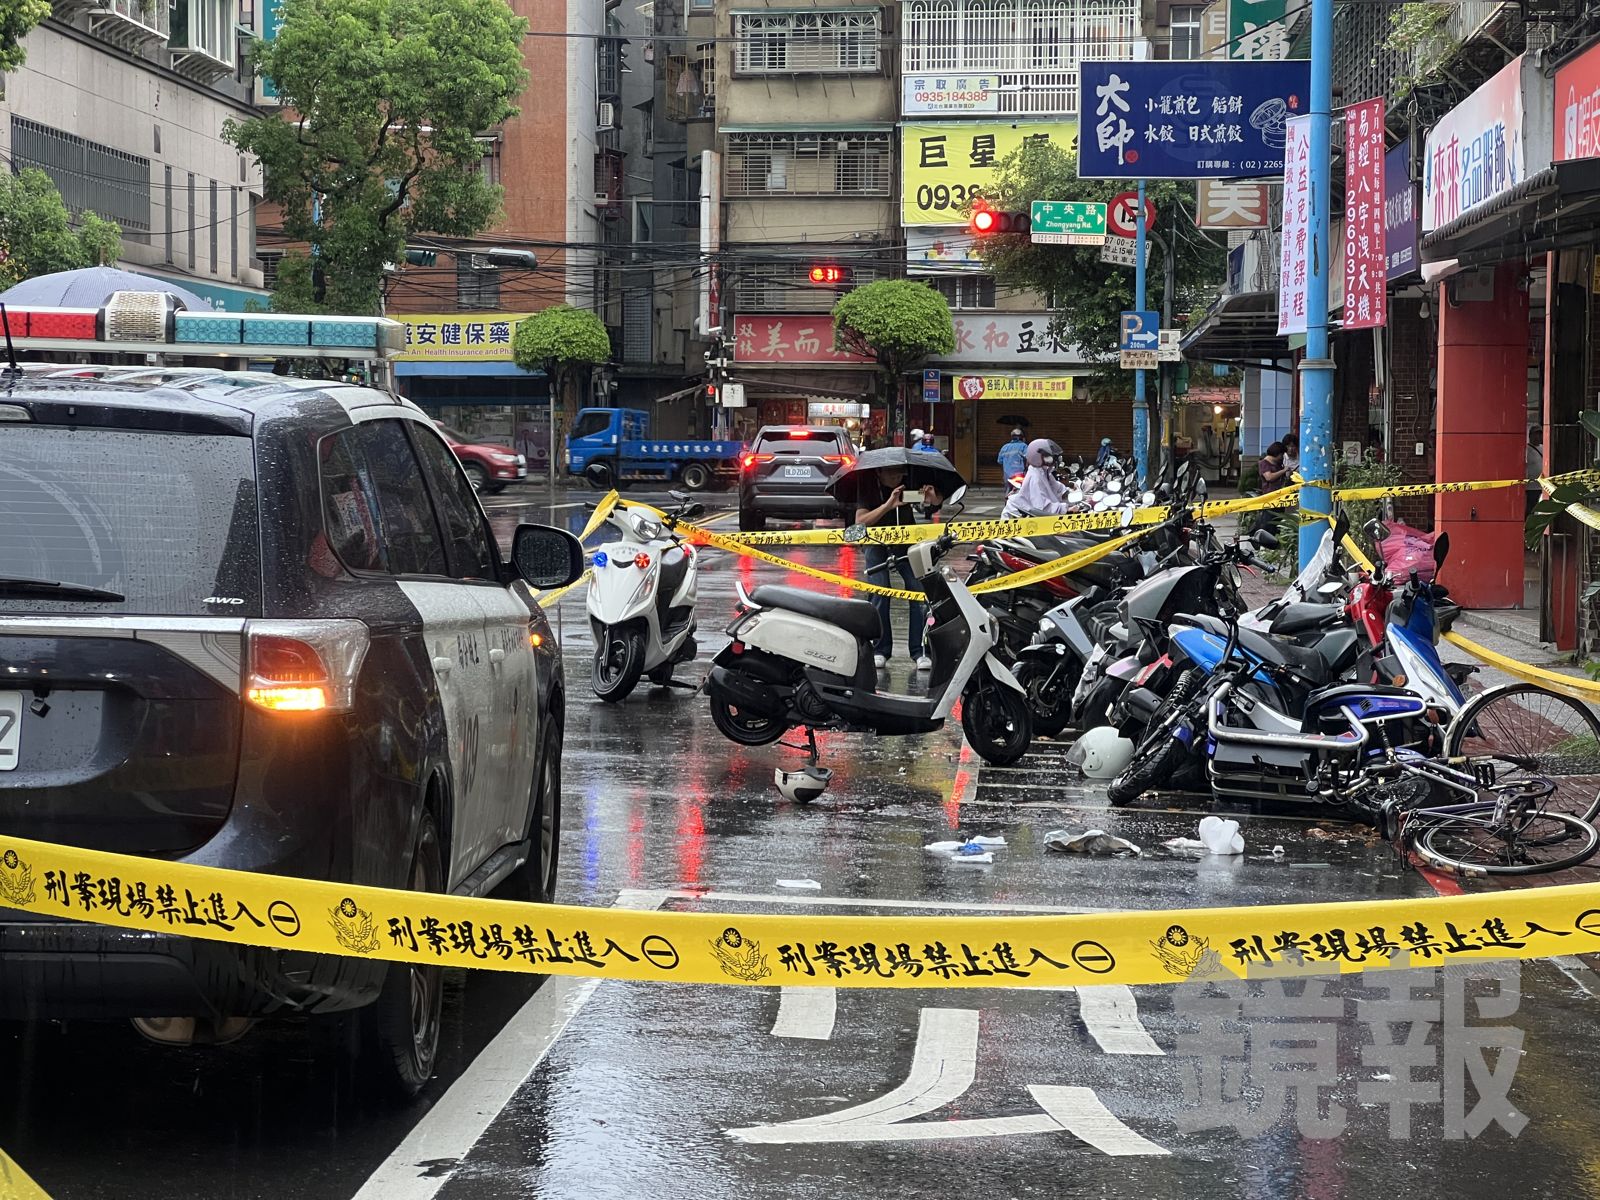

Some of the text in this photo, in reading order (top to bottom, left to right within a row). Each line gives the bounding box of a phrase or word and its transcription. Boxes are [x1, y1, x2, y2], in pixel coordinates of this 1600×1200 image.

[915, 92, 988, 102] 0935-184388
[1144, 95, 1243, 115] 小籠煎包 餡餅
[1096, 73, 1135, 165] 大帥
[1144, 124, 1243, 143] 水餃 日式煎餃
[1042, 203, 1097, 215] 中央路
[1293, 134, 1309, 317] 公益免費課程
[405, 322, 519, 345] 安健保藥
[954, 320, 1084, 354] 永和豆漿
[424, 348, 448, 356] Health
[449, 348, 483, 356] Insurance
[499, 347, 513, 355] Pha
[202, 597, 245, 605] 4WD
[43, 870, 267, 932] 刑案現場禁止進入
[387, 916, 640, 968] 刑案現場禁止進入
[1228, 917, 1572, 968] 刑案現場禁止進入
[777, 941, 1070, 980] 刑案現場禁止進入
